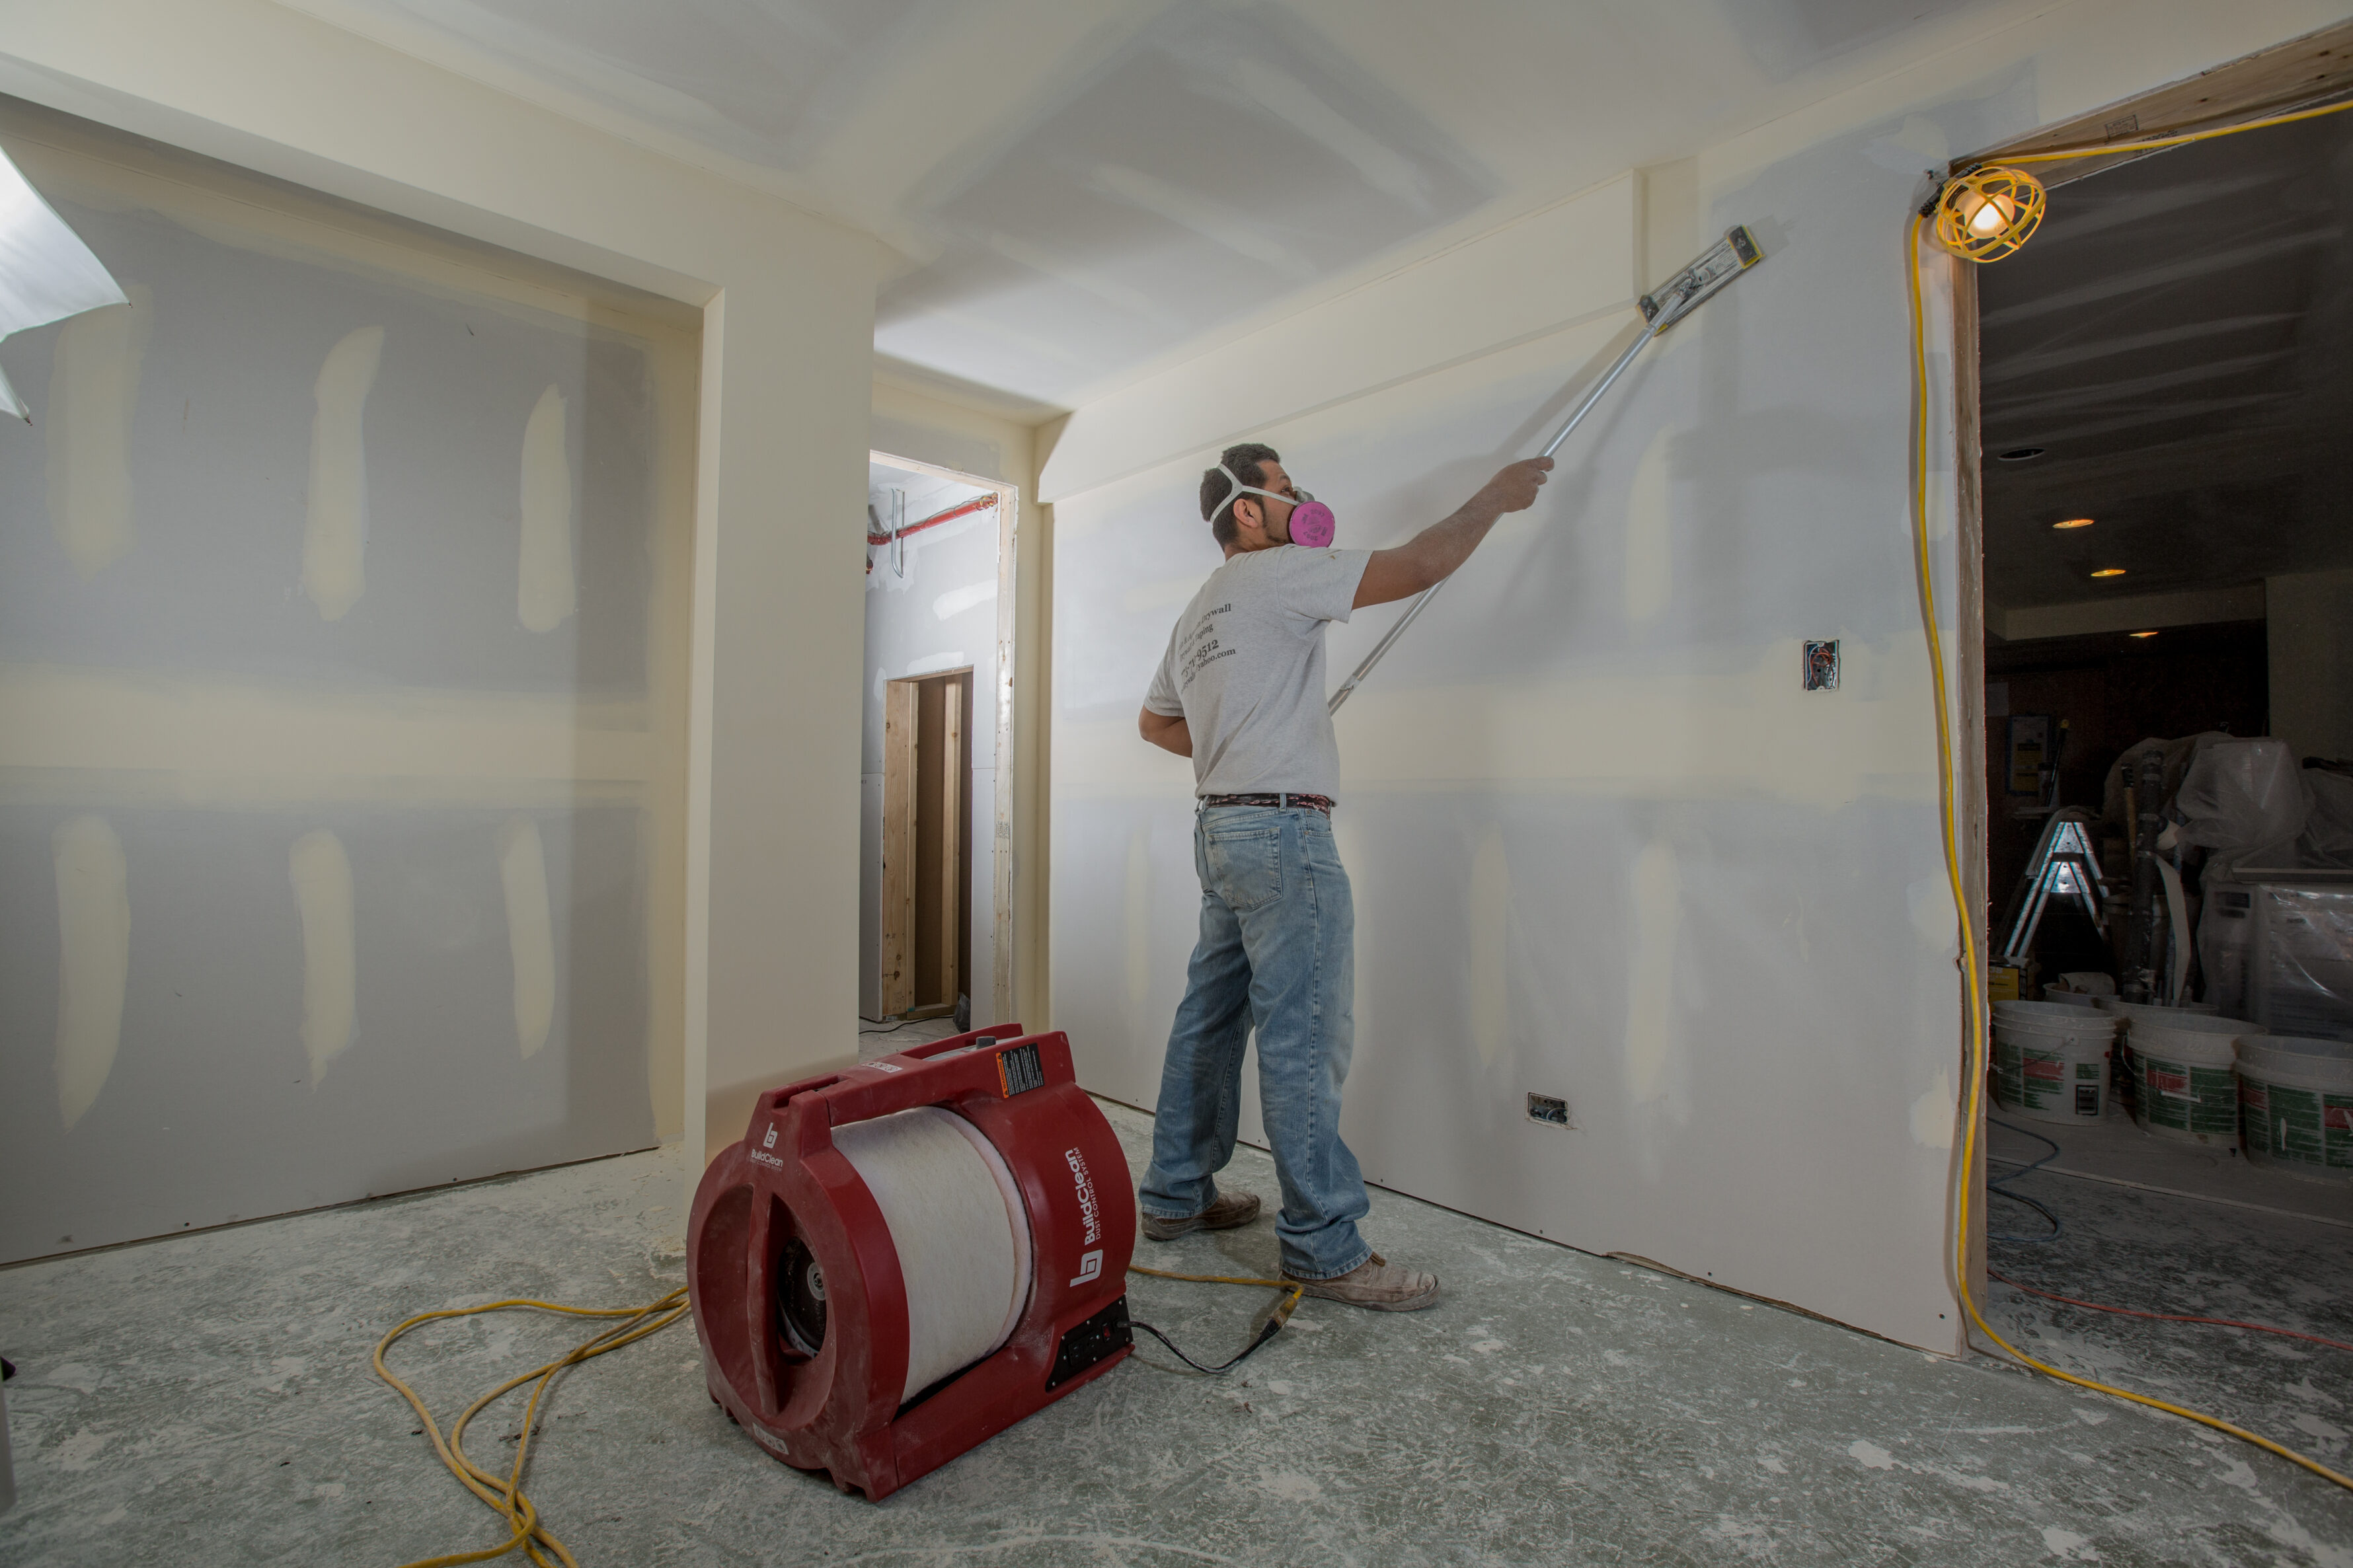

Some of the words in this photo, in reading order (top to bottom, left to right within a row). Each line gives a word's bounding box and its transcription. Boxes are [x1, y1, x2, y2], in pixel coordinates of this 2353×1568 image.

[752, 1148, 783, 1167] BuildClean
[1073, 1146, 1089, 1176] SYSTEM
[1065, 1149, 1095, 1246] BuildClean
[1086, 1177, 1099, 1218] CONTROL
